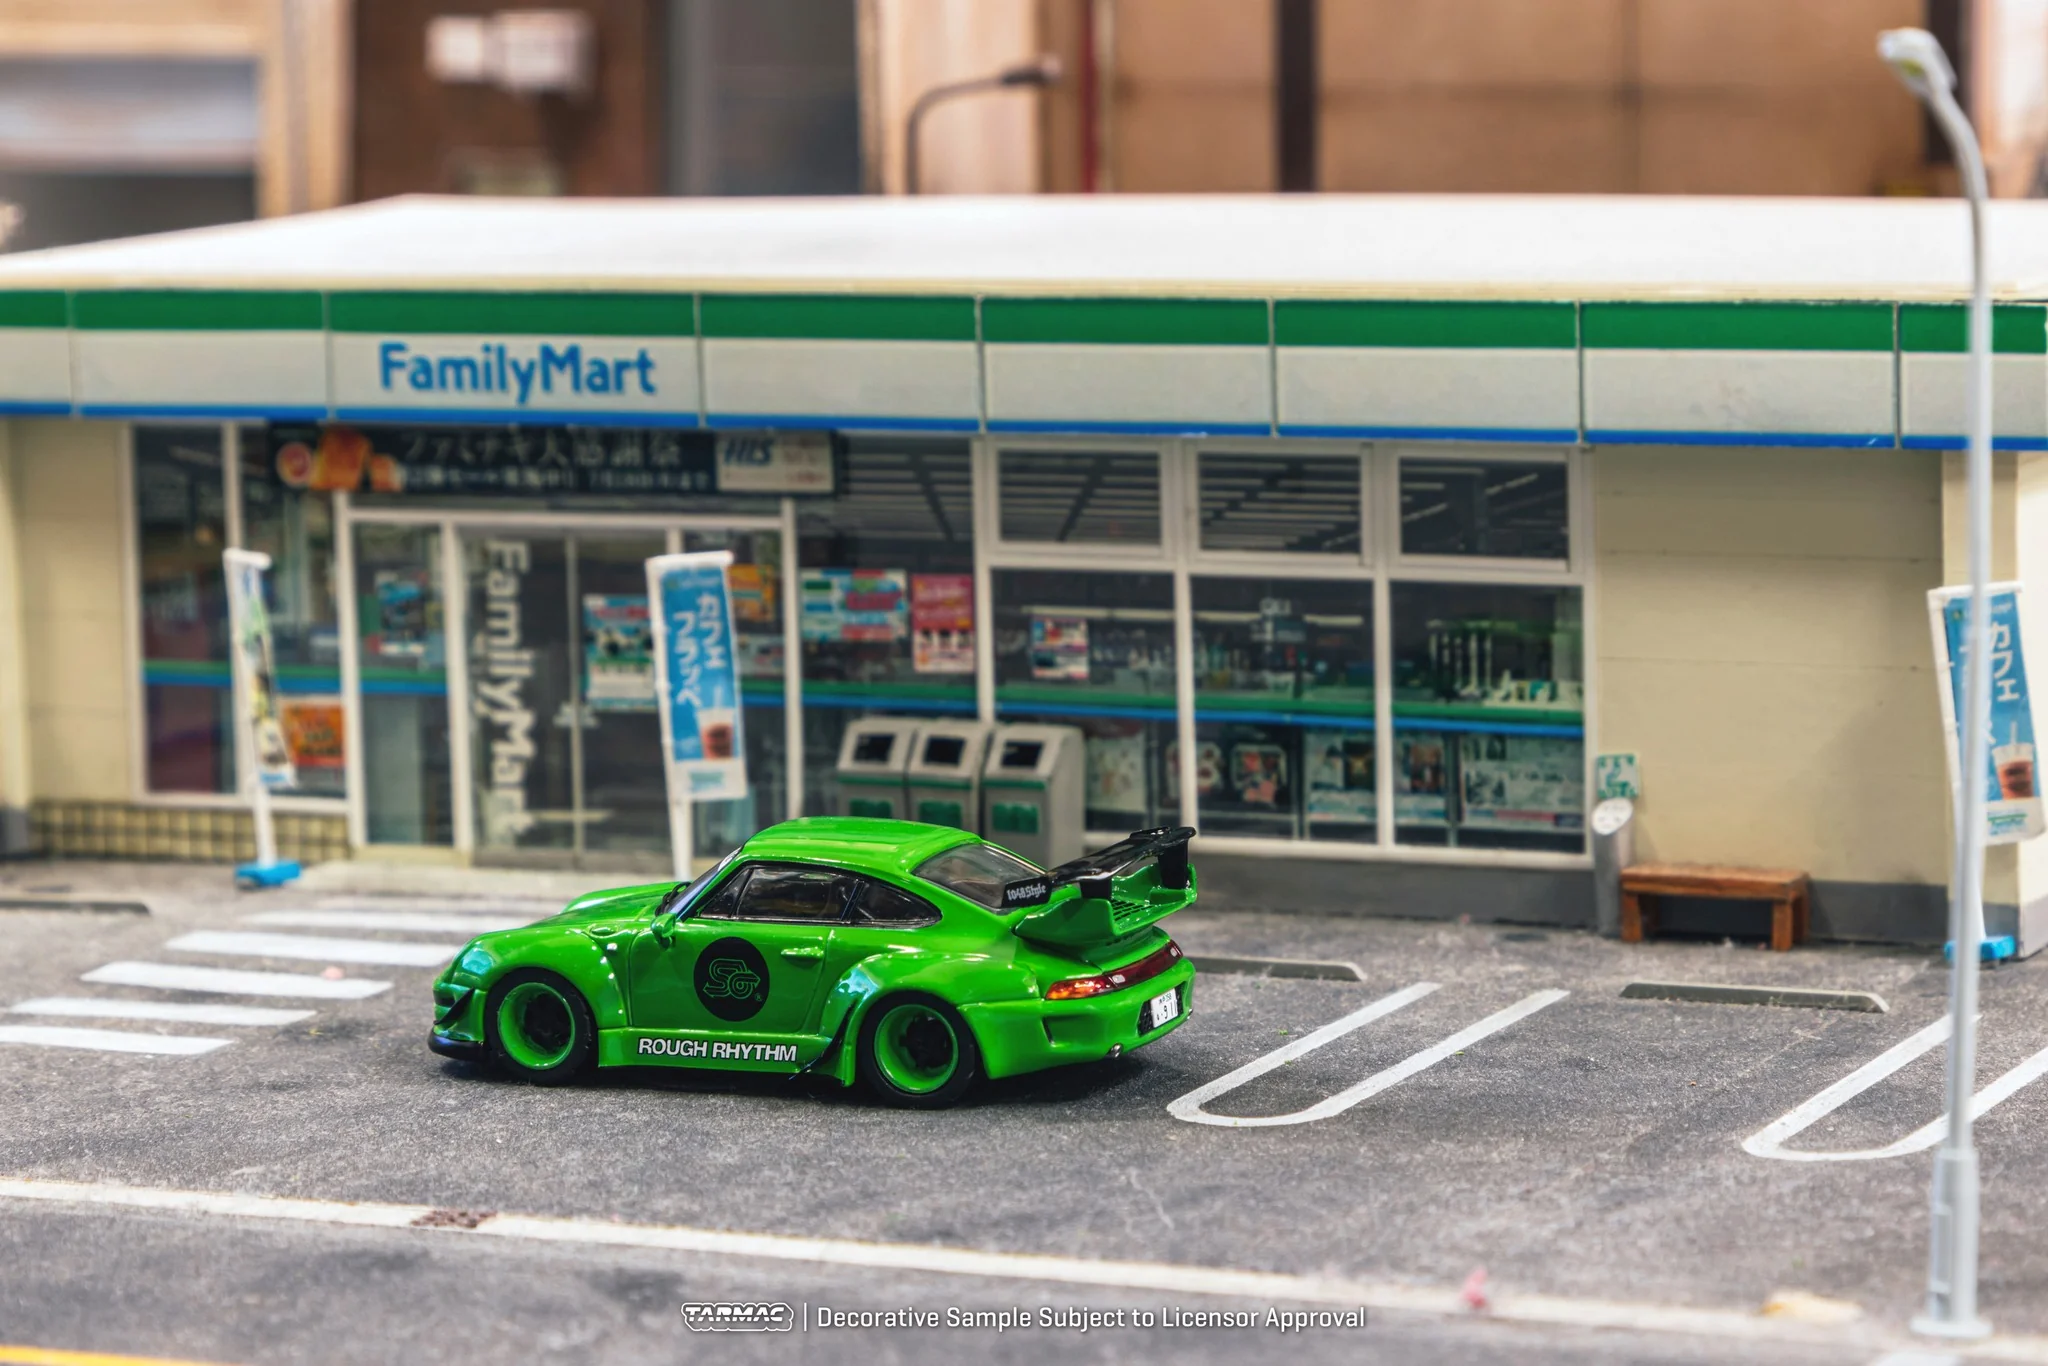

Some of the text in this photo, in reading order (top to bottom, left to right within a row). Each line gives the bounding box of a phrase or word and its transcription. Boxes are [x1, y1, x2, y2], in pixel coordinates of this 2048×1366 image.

[379, 340, 656, 405] FamilyMart
[475, 541, 538, 834] FamilyMart
[1990, 621, 2019, 702] カフェ
[638, 1038, 797, 1062] ROUGH RHYTHM
